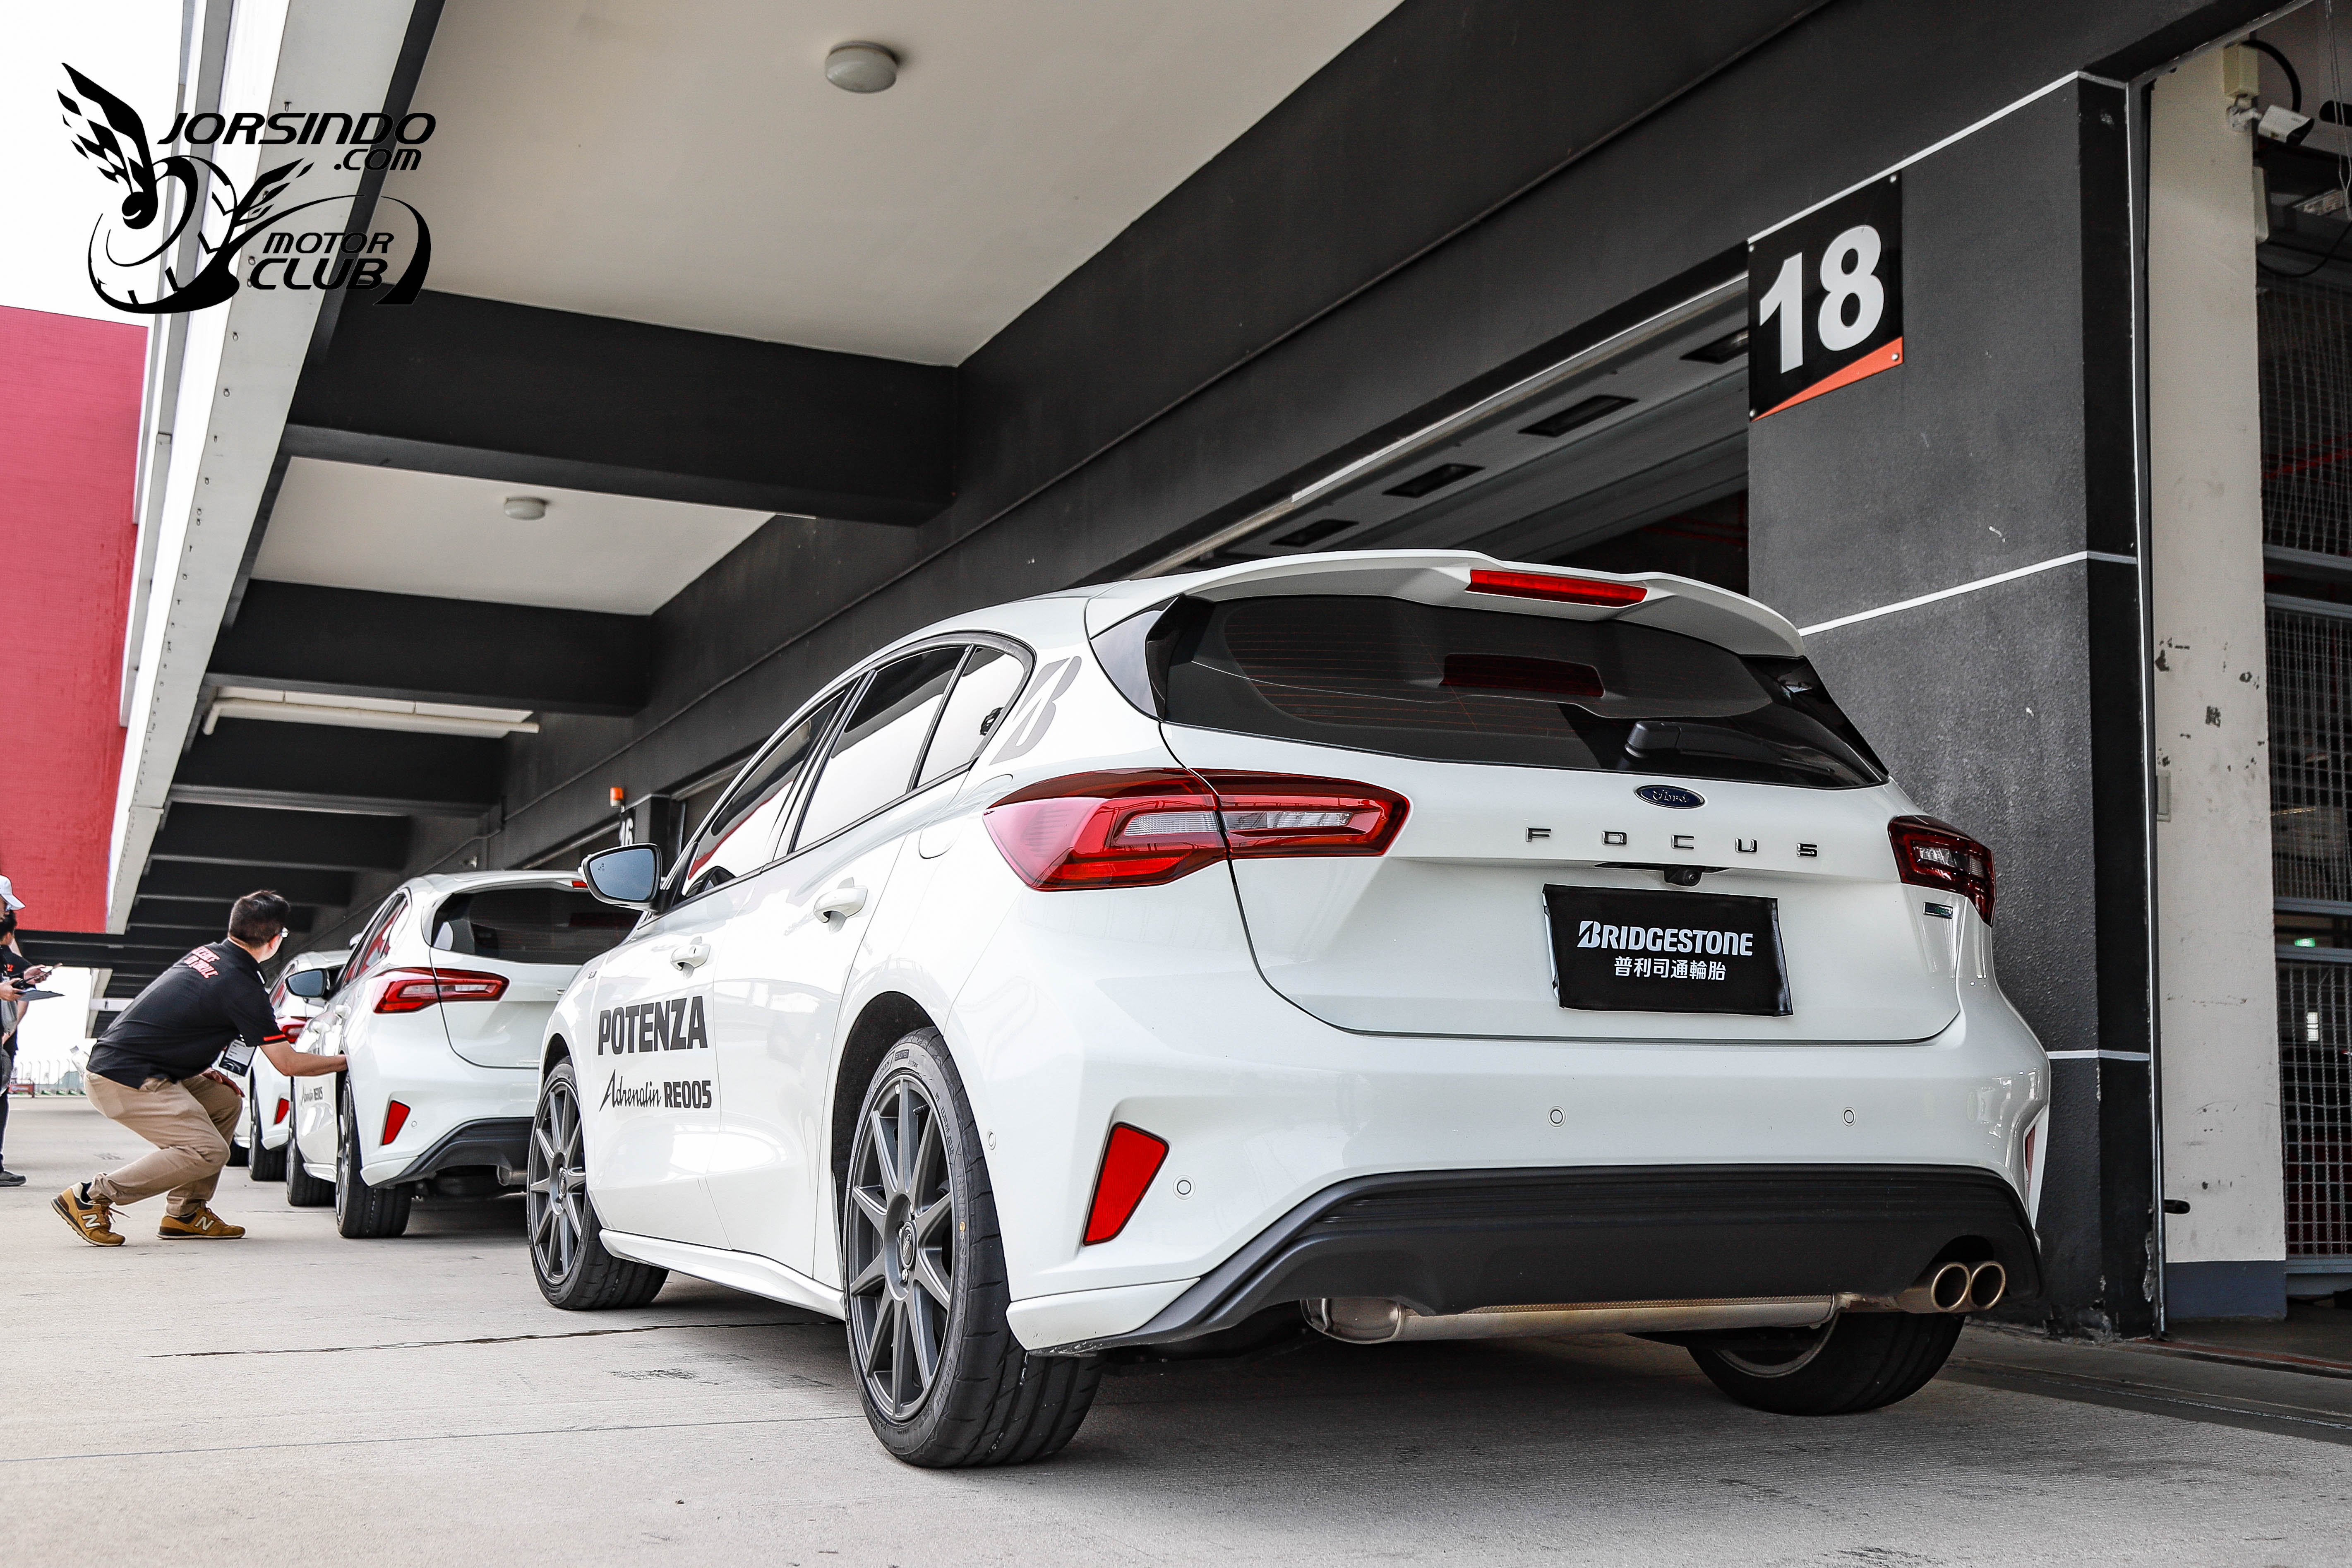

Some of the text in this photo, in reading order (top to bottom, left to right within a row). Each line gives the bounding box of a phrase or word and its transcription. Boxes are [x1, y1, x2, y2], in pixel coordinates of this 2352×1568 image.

[1759, 225, 1884, 374] 18
[1525, 827, 1819, 858] FOCUS
[1577, 921, 1753, 956] BRIDGESTONE
[1614, 956, 1726, 980] 普利司通輪胎
[598, 995, 708, 1056] POTENZA
[599, 1069, 712, 1112] Adrenalin RE005
